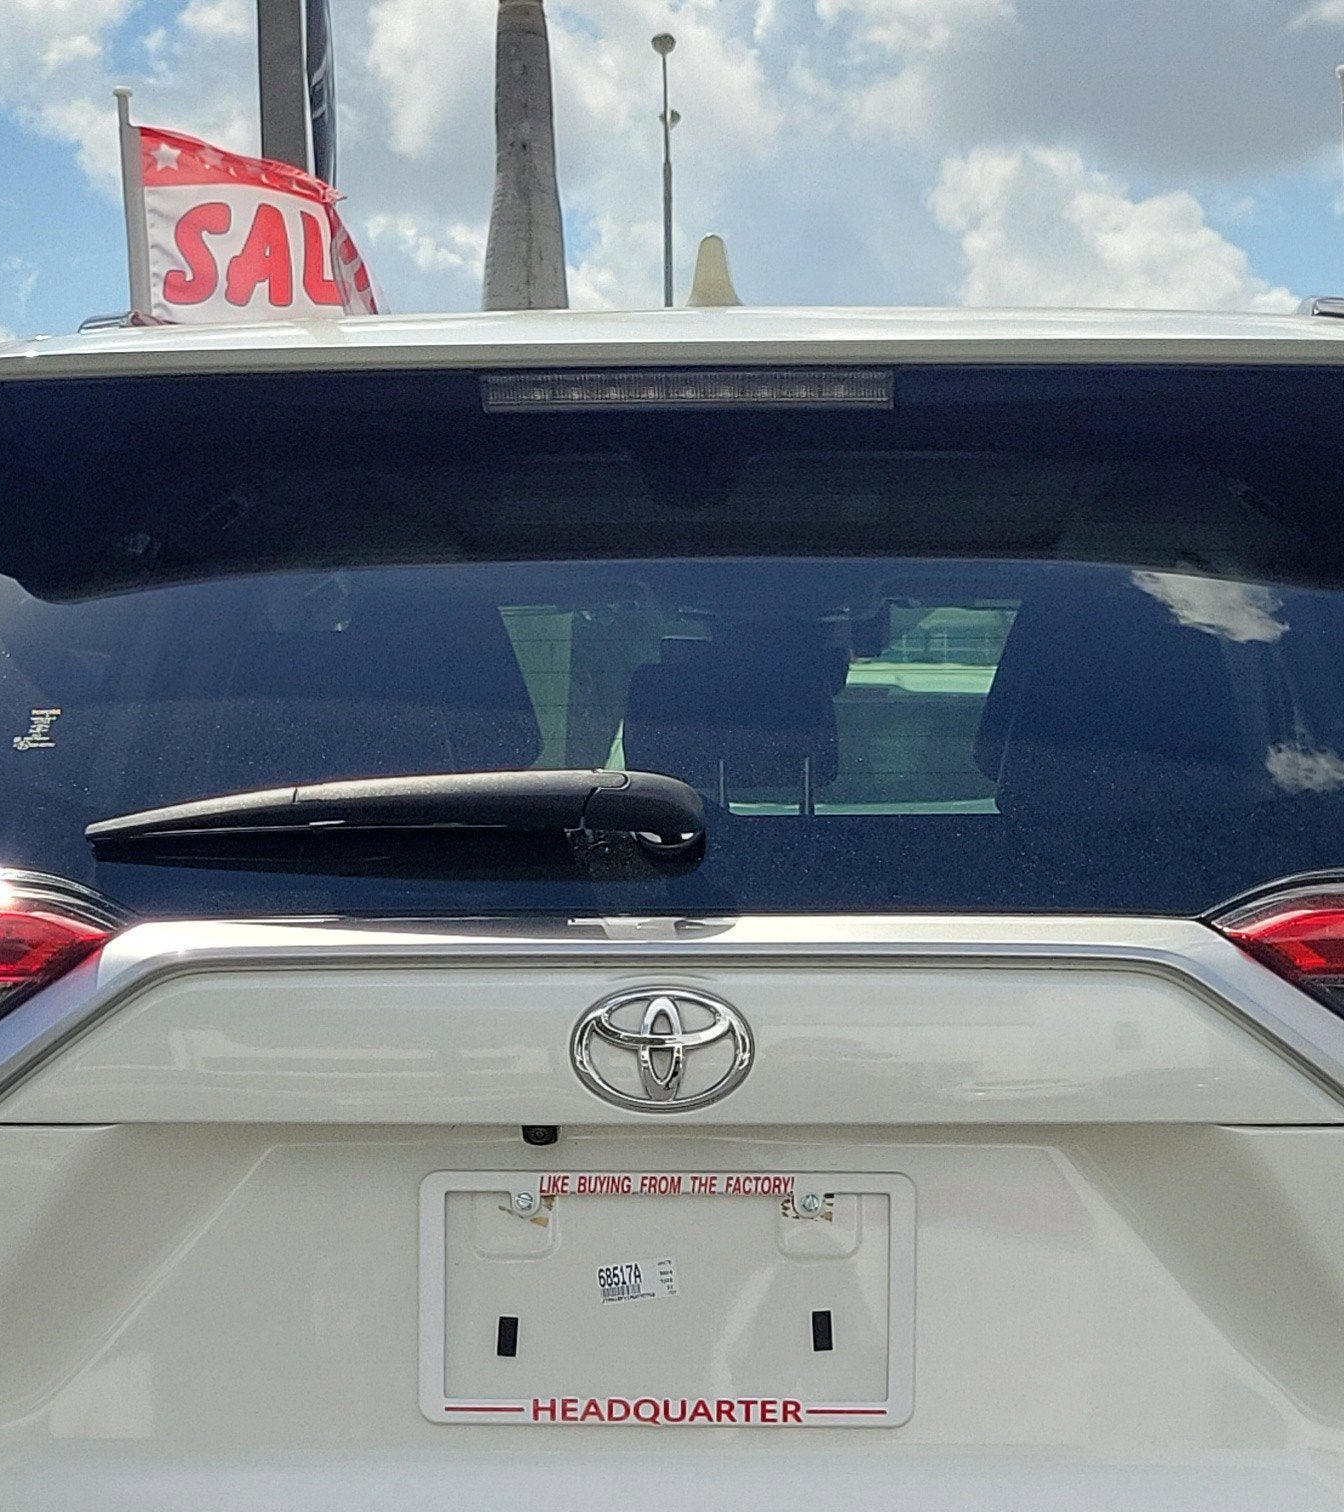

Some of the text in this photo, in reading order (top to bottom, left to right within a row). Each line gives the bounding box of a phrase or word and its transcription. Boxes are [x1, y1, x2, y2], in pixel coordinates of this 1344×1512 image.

[539, 1175, 795, 1196] LIKE BUYING FROM THE FACTORY!
[597, 1262, 643, 1288] 68517A
[532, 1398, 803, 1425] HEADQUARTER
